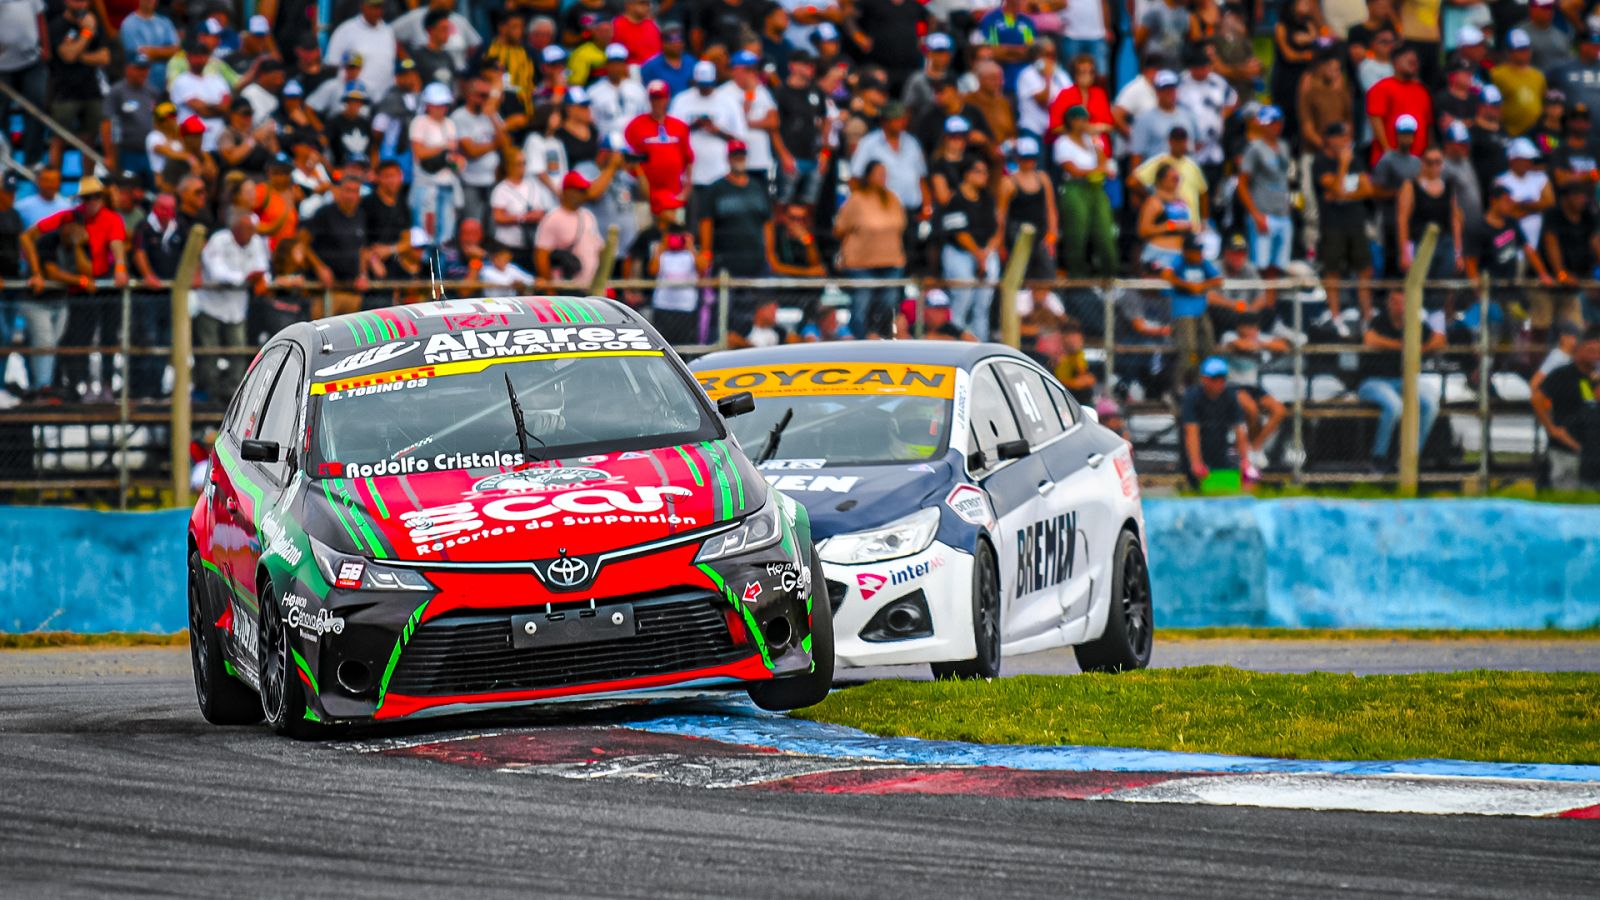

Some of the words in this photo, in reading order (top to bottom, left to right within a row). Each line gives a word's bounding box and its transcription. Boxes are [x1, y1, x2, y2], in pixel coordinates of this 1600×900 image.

[423, 327, 649, 355] Alvarez
[424, 341, 652, 364] NEUMATICOS
[347, 381, 404, 398] TODINO
[346, 456, 429, 479] Rodolfo
[434, 450, 525, 470] Cristales
[415, 524, 516, 556] Resortes
[525, 519, 554, 531] de
[563, 513, 697, 527] Suspensión
[1016, 510, 1076, 599] BREMEN
